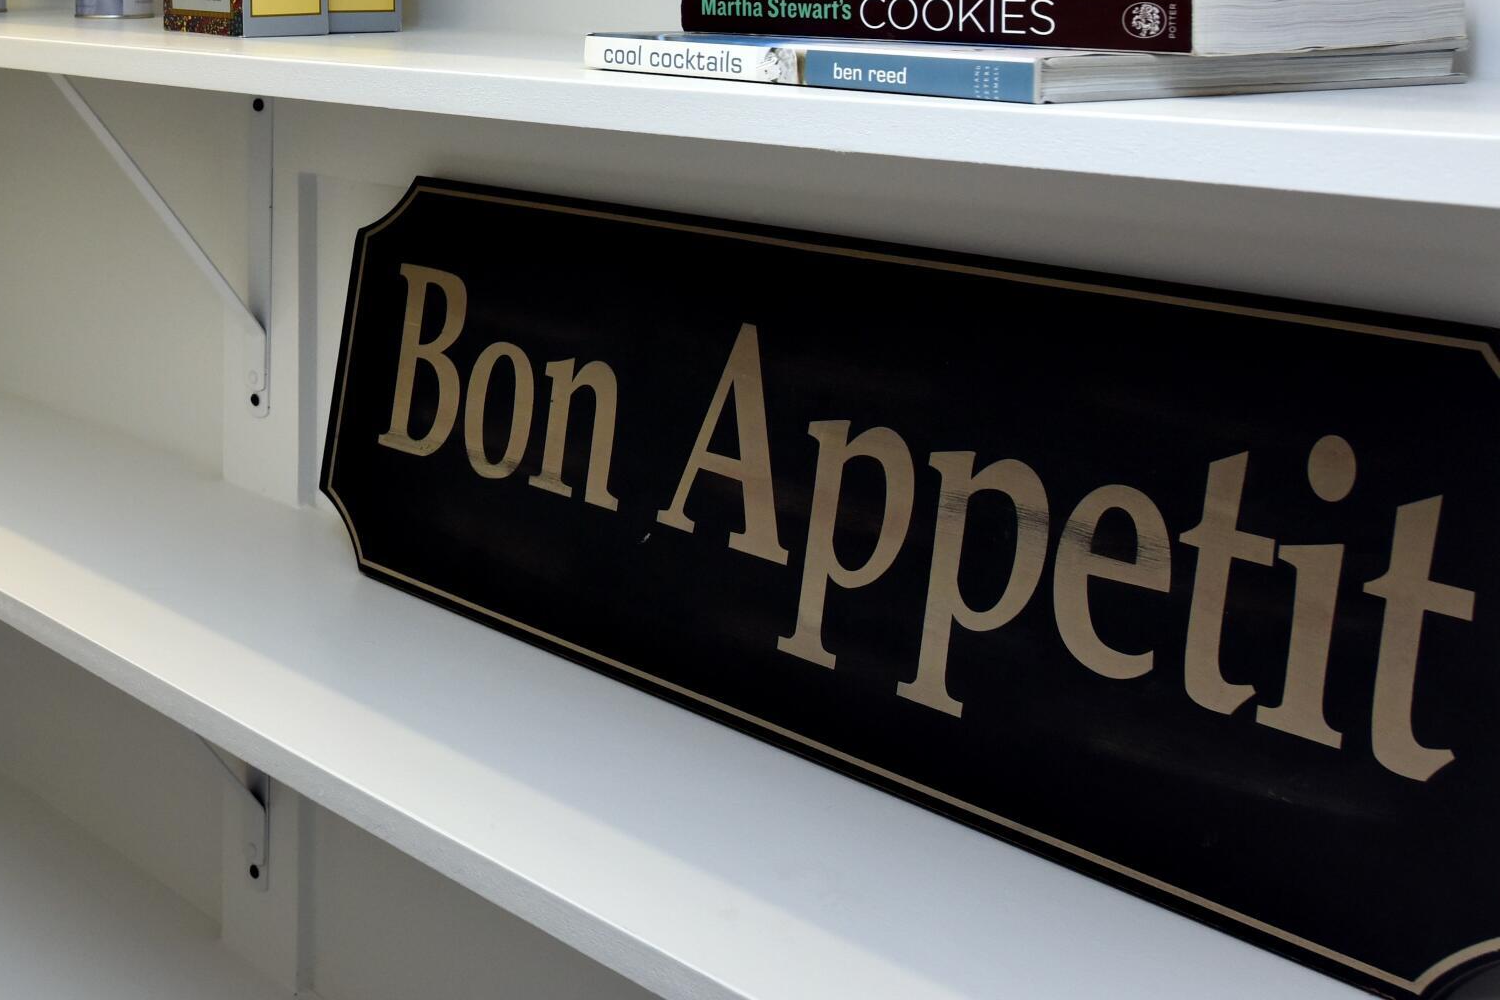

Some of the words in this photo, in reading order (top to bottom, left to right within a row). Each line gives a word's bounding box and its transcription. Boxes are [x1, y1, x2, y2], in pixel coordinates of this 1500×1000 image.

[1168, 3, 1177, 39] POTTER
[603, 45, 642, 66] cool
[649, 46, 743, 75] cocktails
[833, 63, 865, 82] ben
[869, 65, 907, 84] reed
[378, 263, 619, 512] Bon
[656, 323, 1474, 782] Appetit
